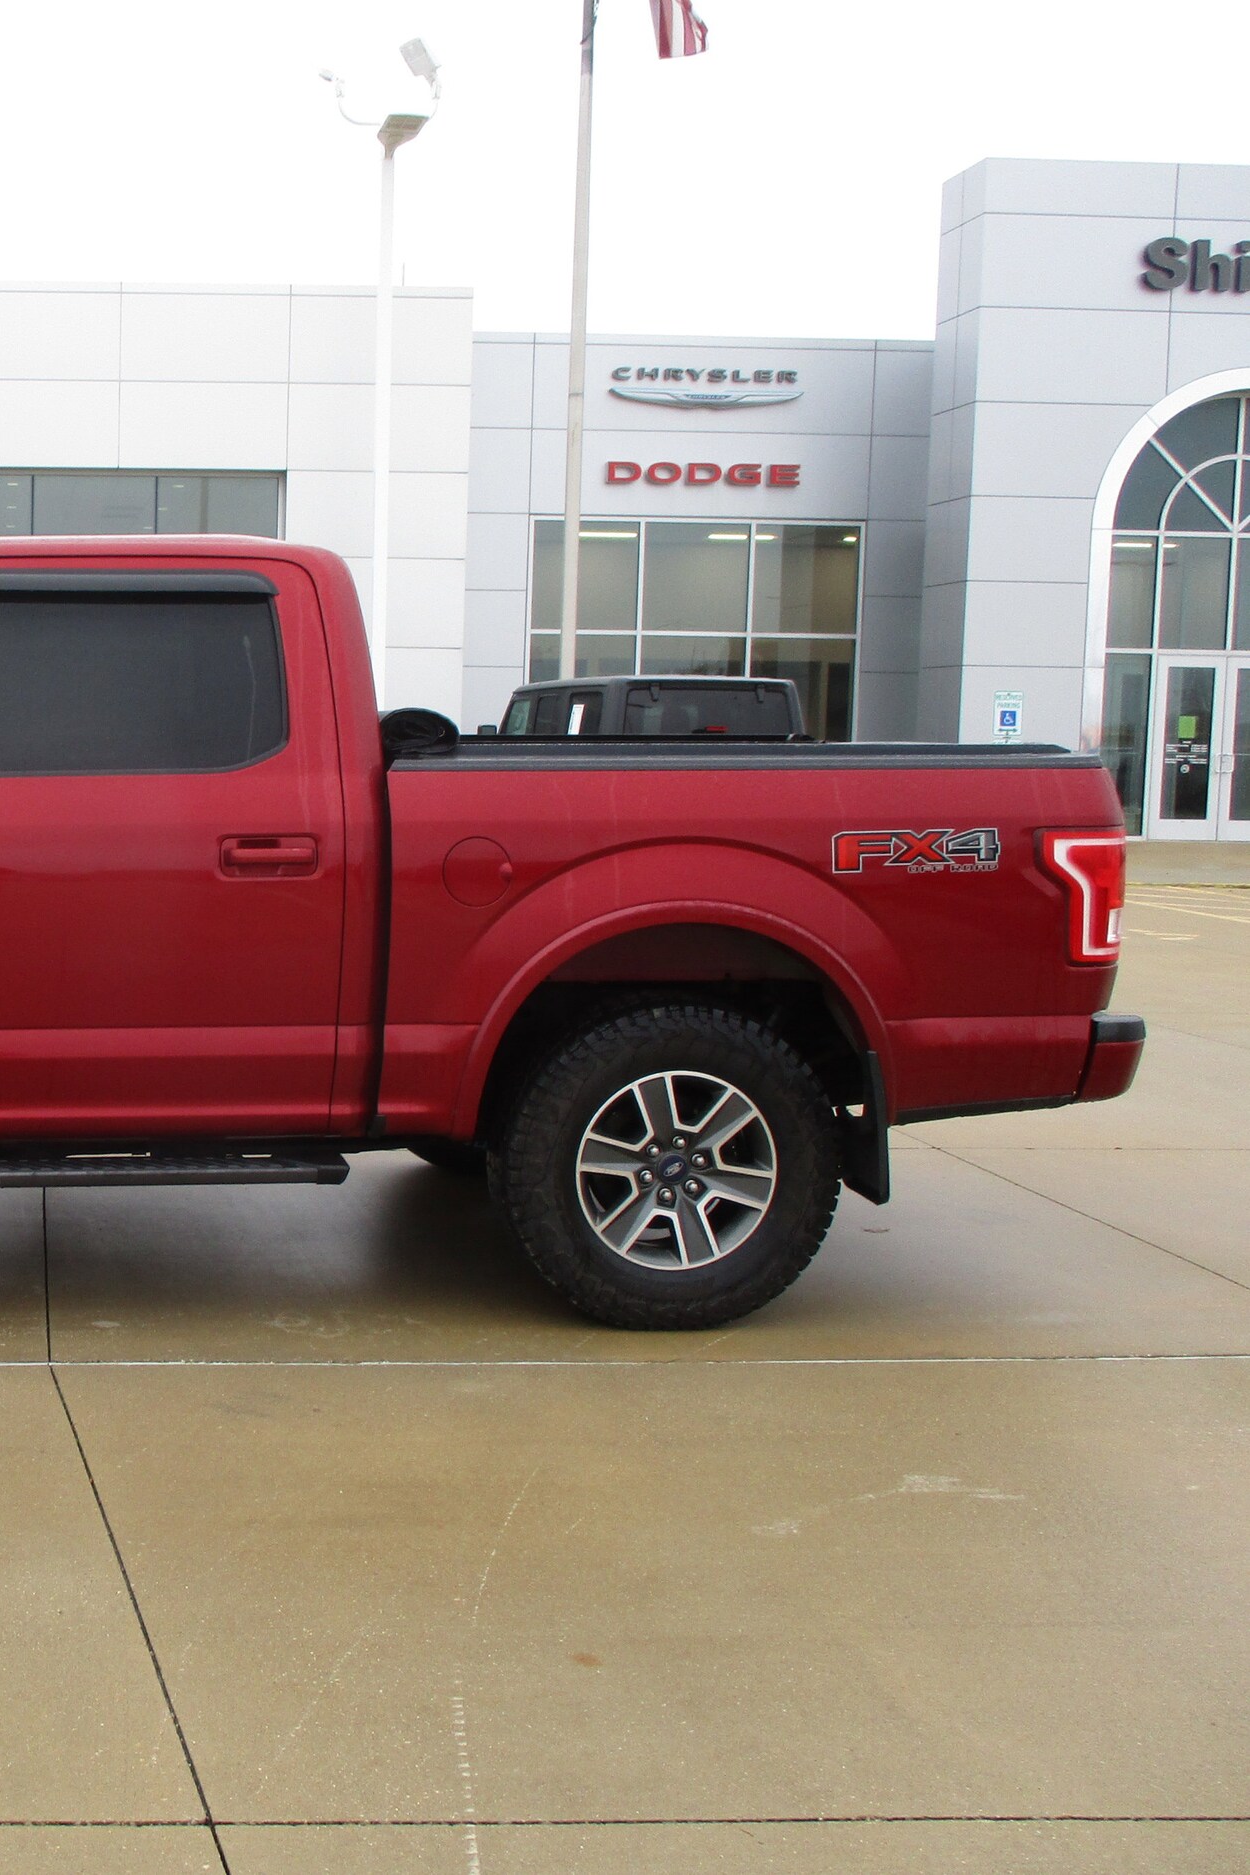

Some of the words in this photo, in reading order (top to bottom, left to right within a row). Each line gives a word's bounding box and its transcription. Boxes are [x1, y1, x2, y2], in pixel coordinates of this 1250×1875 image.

[1140, 237, 1250, 293] Shi
[611, 367, 798, 383] CHRYSLER
[605, 461, 801, 487] DODGE
[832, 828, 1000, 873] FX4
[908, 865, 945, 873] OFF
[951, 864, 999, 872] ROAD
